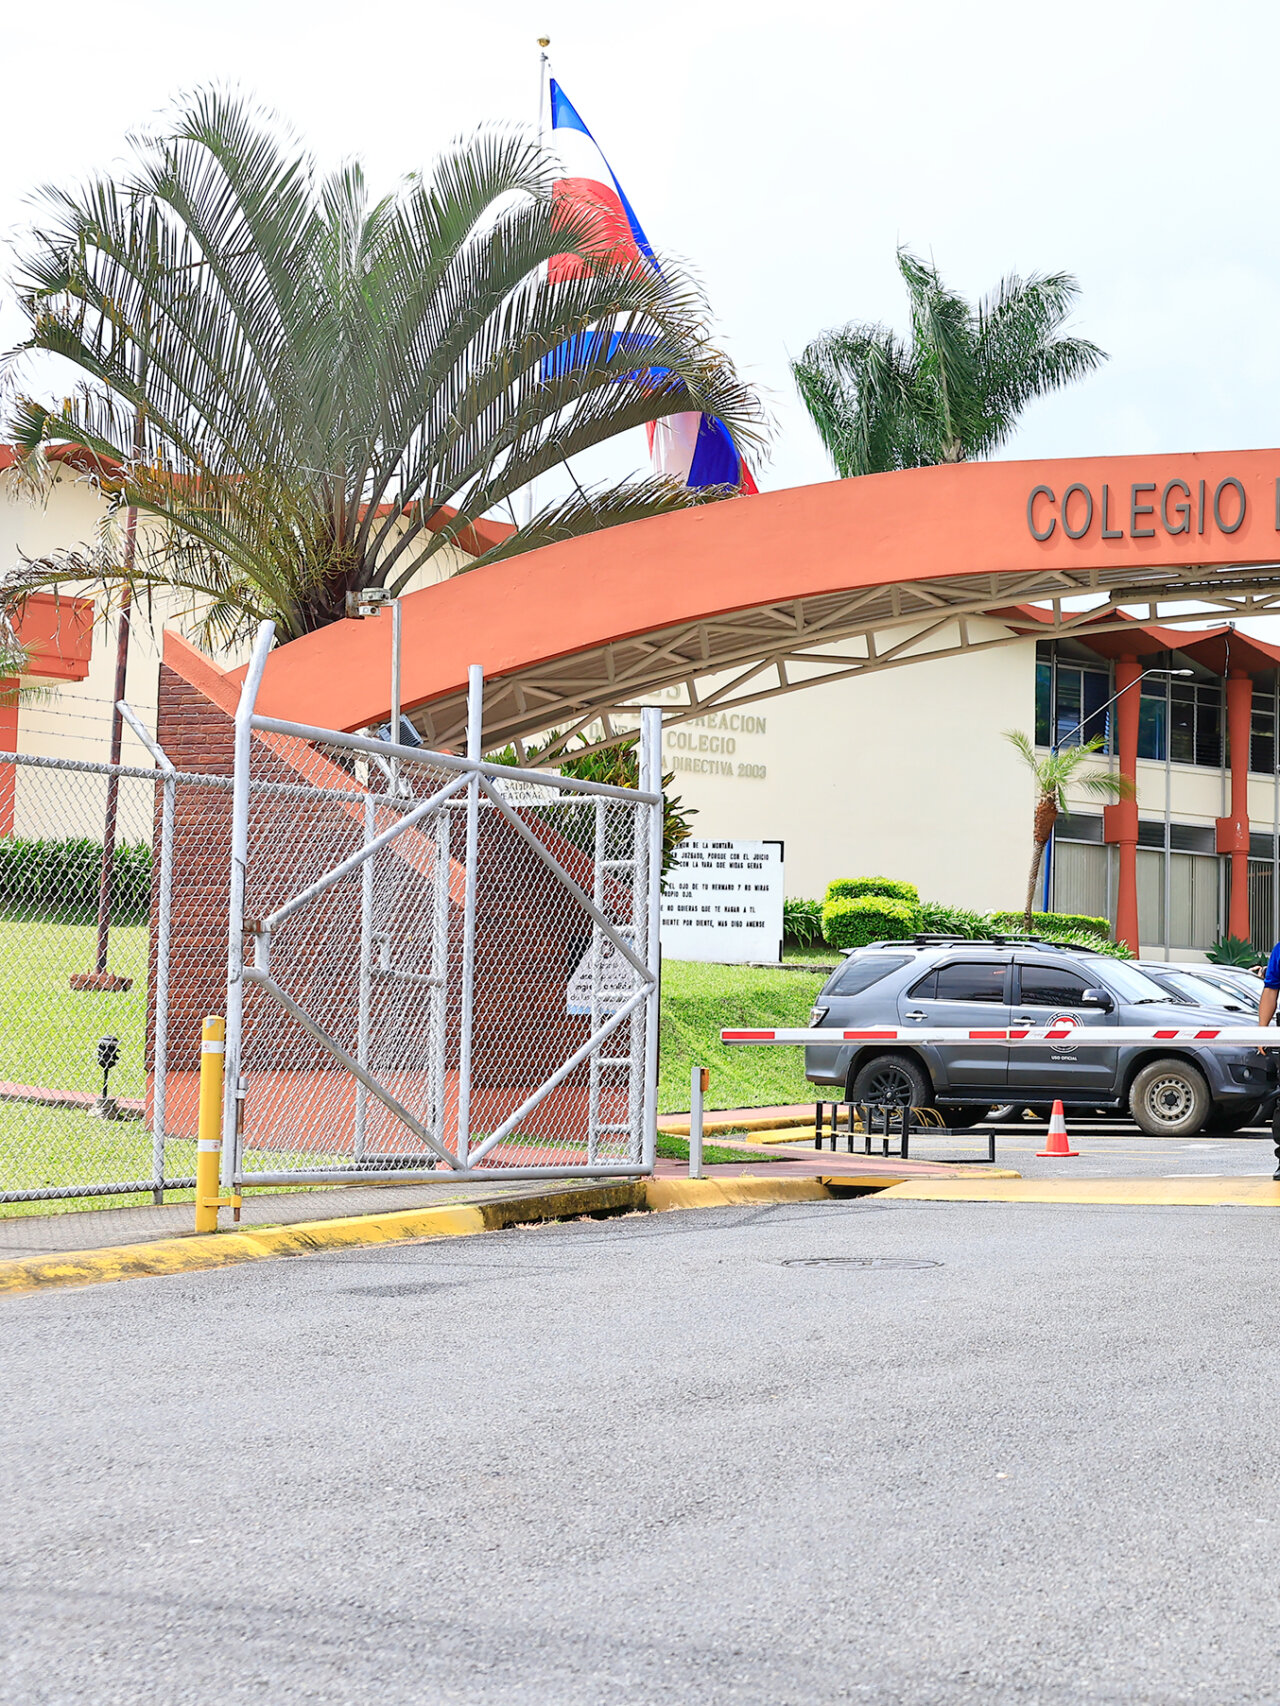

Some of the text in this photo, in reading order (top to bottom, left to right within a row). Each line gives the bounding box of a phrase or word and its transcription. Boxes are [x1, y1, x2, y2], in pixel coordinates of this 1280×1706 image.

[1026, 476, 1247, 542] COLEGIO
[685, 712, 767, 734] REACION
[666, 730, 736, 755] COLEGIO
[672, 756, 735, 776] DIRECTIVA
[738, 764, 767, 779] 2003
